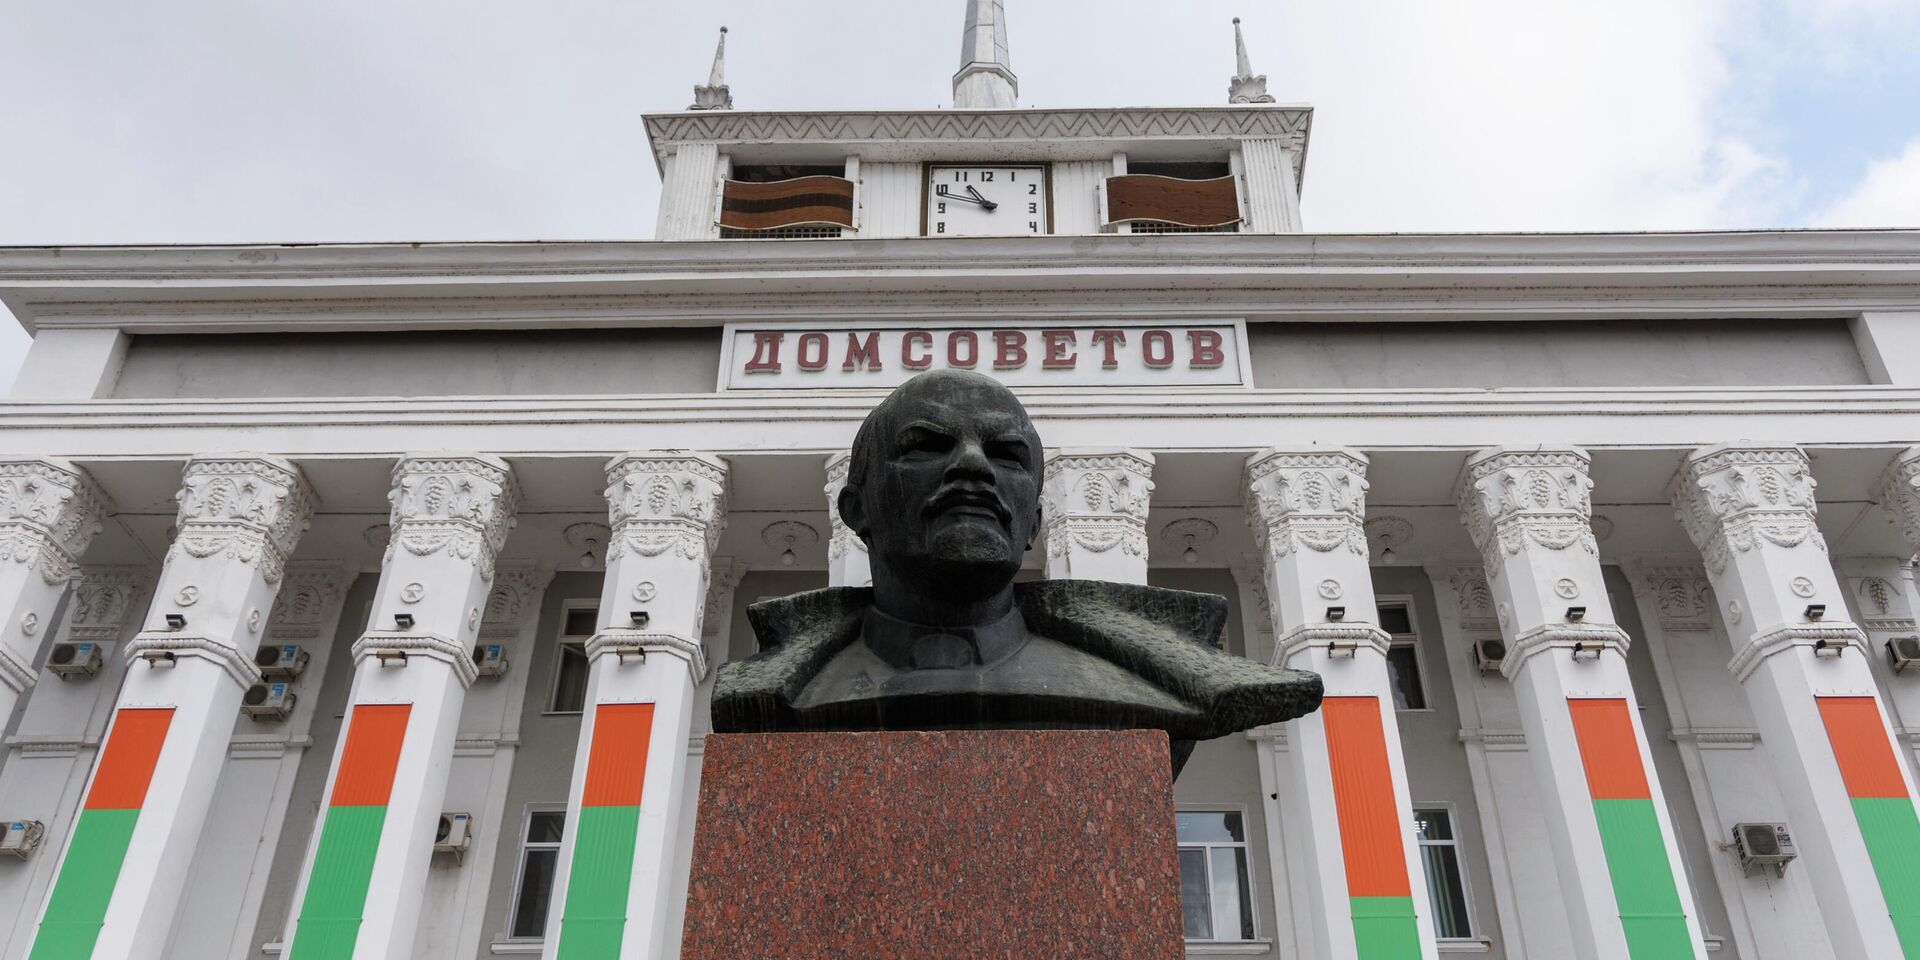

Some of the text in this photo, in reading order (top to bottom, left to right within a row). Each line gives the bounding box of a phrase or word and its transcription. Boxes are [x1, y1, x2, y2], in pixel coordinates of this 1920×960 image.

[955, 171, 1015, 182] 11 12 1
[1028, 184, 1037, 195] 2
[937, 202, 946, 214] 9
[1028, 202, 1037, 214] 3
[937, 222, 945, 233] 8
[1029, 221, 1037, 233] 4
